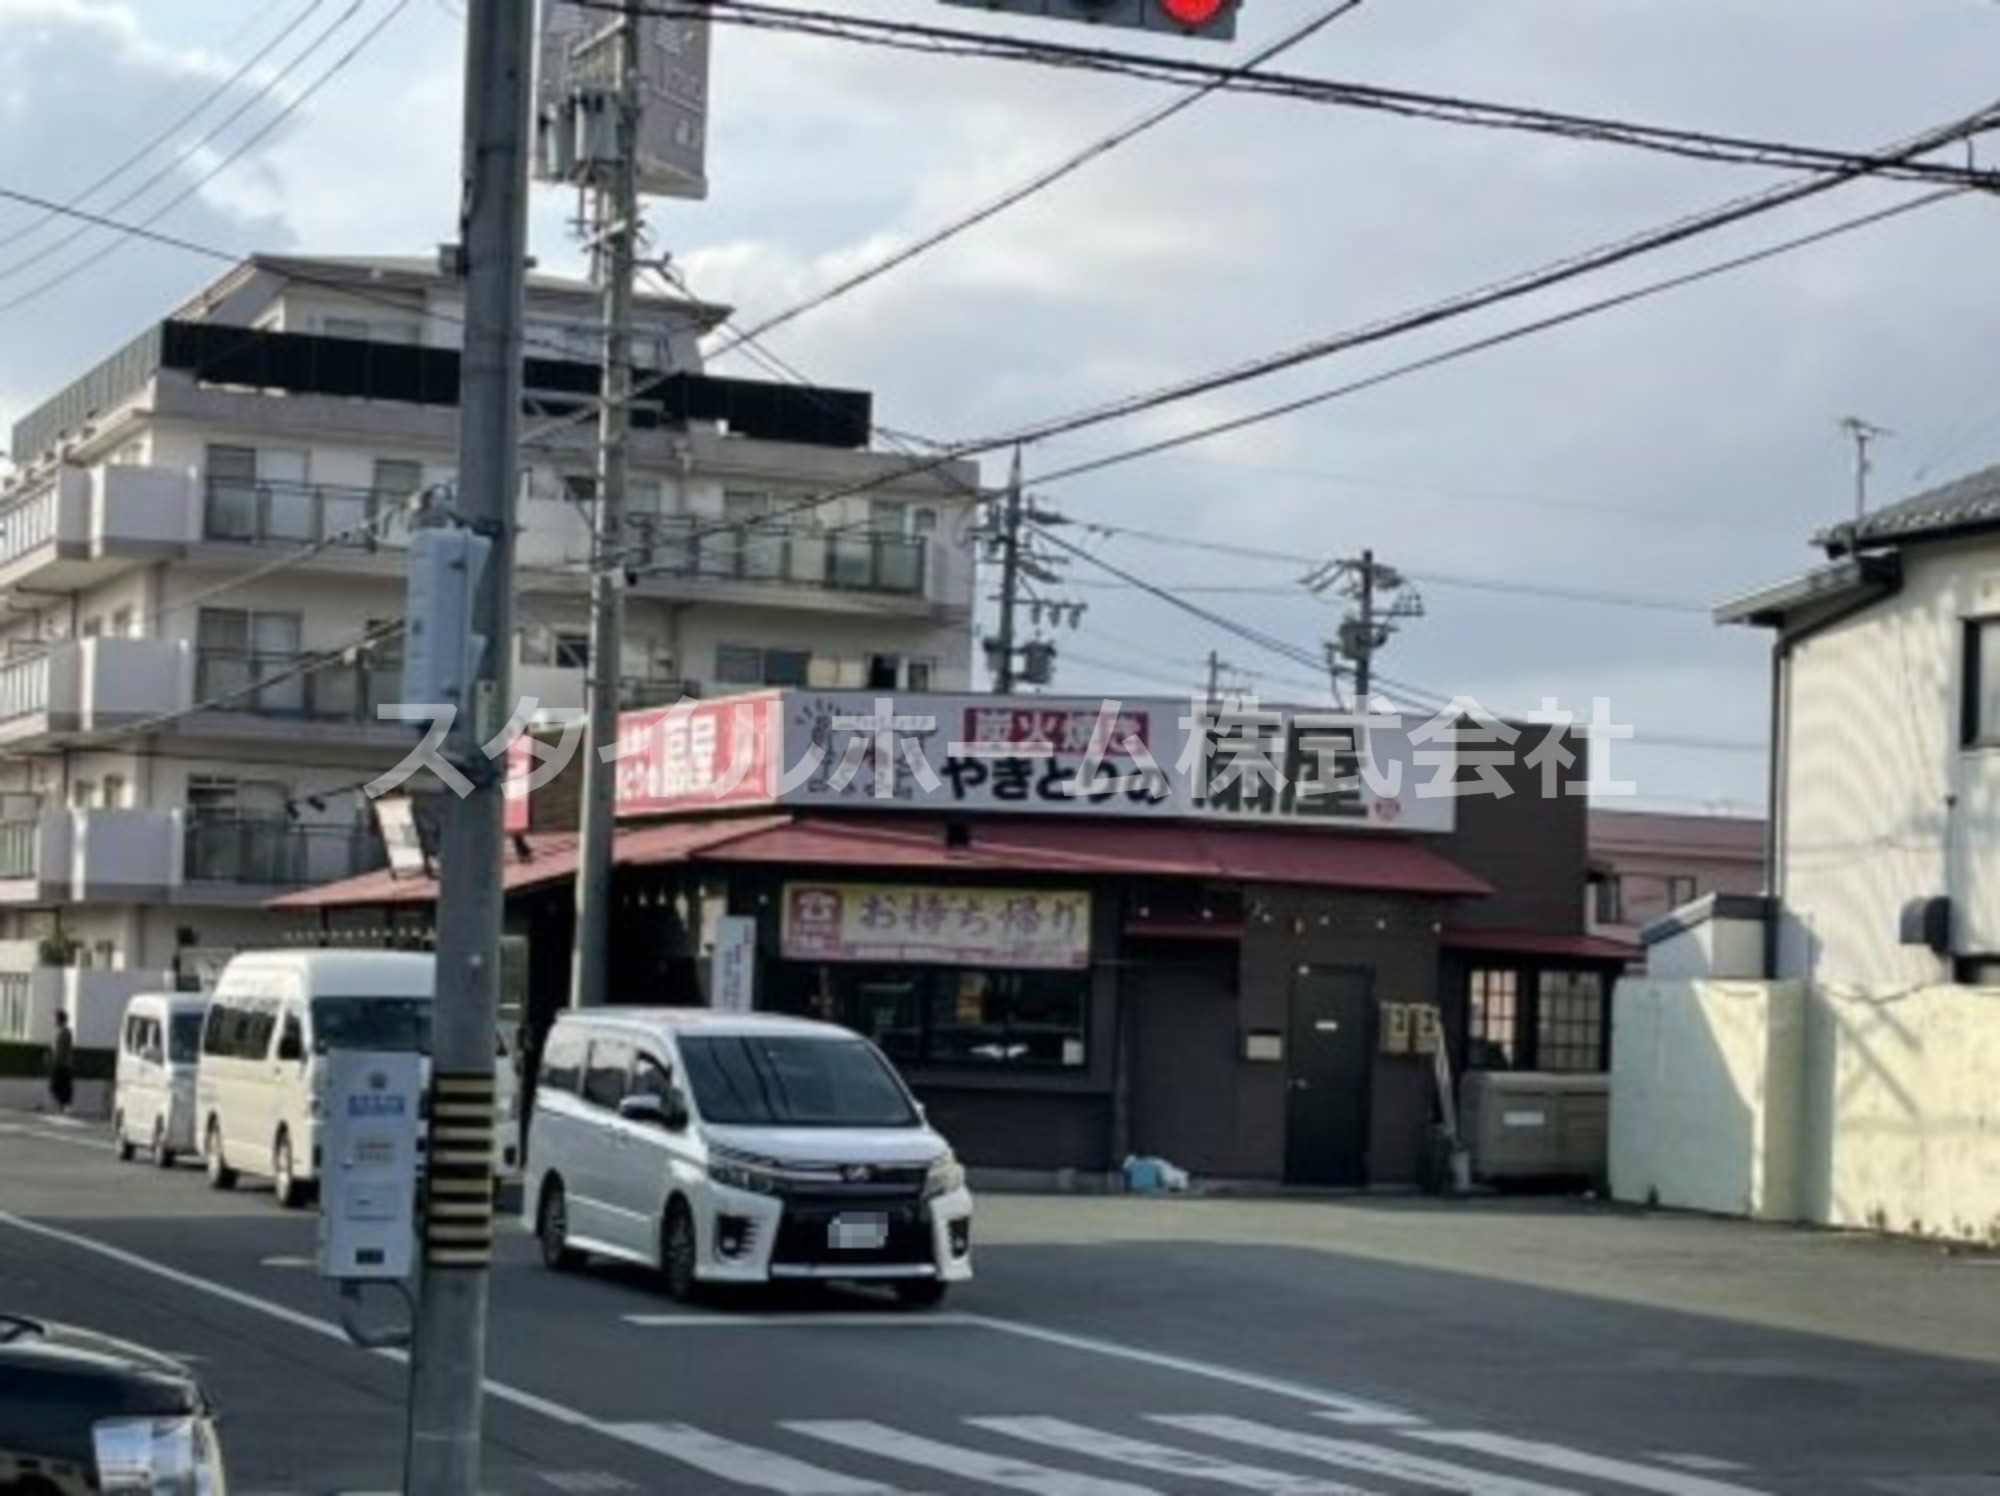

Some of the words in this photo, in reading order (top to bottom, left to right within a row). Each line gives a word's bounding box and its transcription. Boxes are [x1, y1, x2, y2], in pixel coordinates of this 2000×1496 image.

[940, 756, 1170, 805] やきとりの
[859, 890, 1080, 938] お持ち帰り
